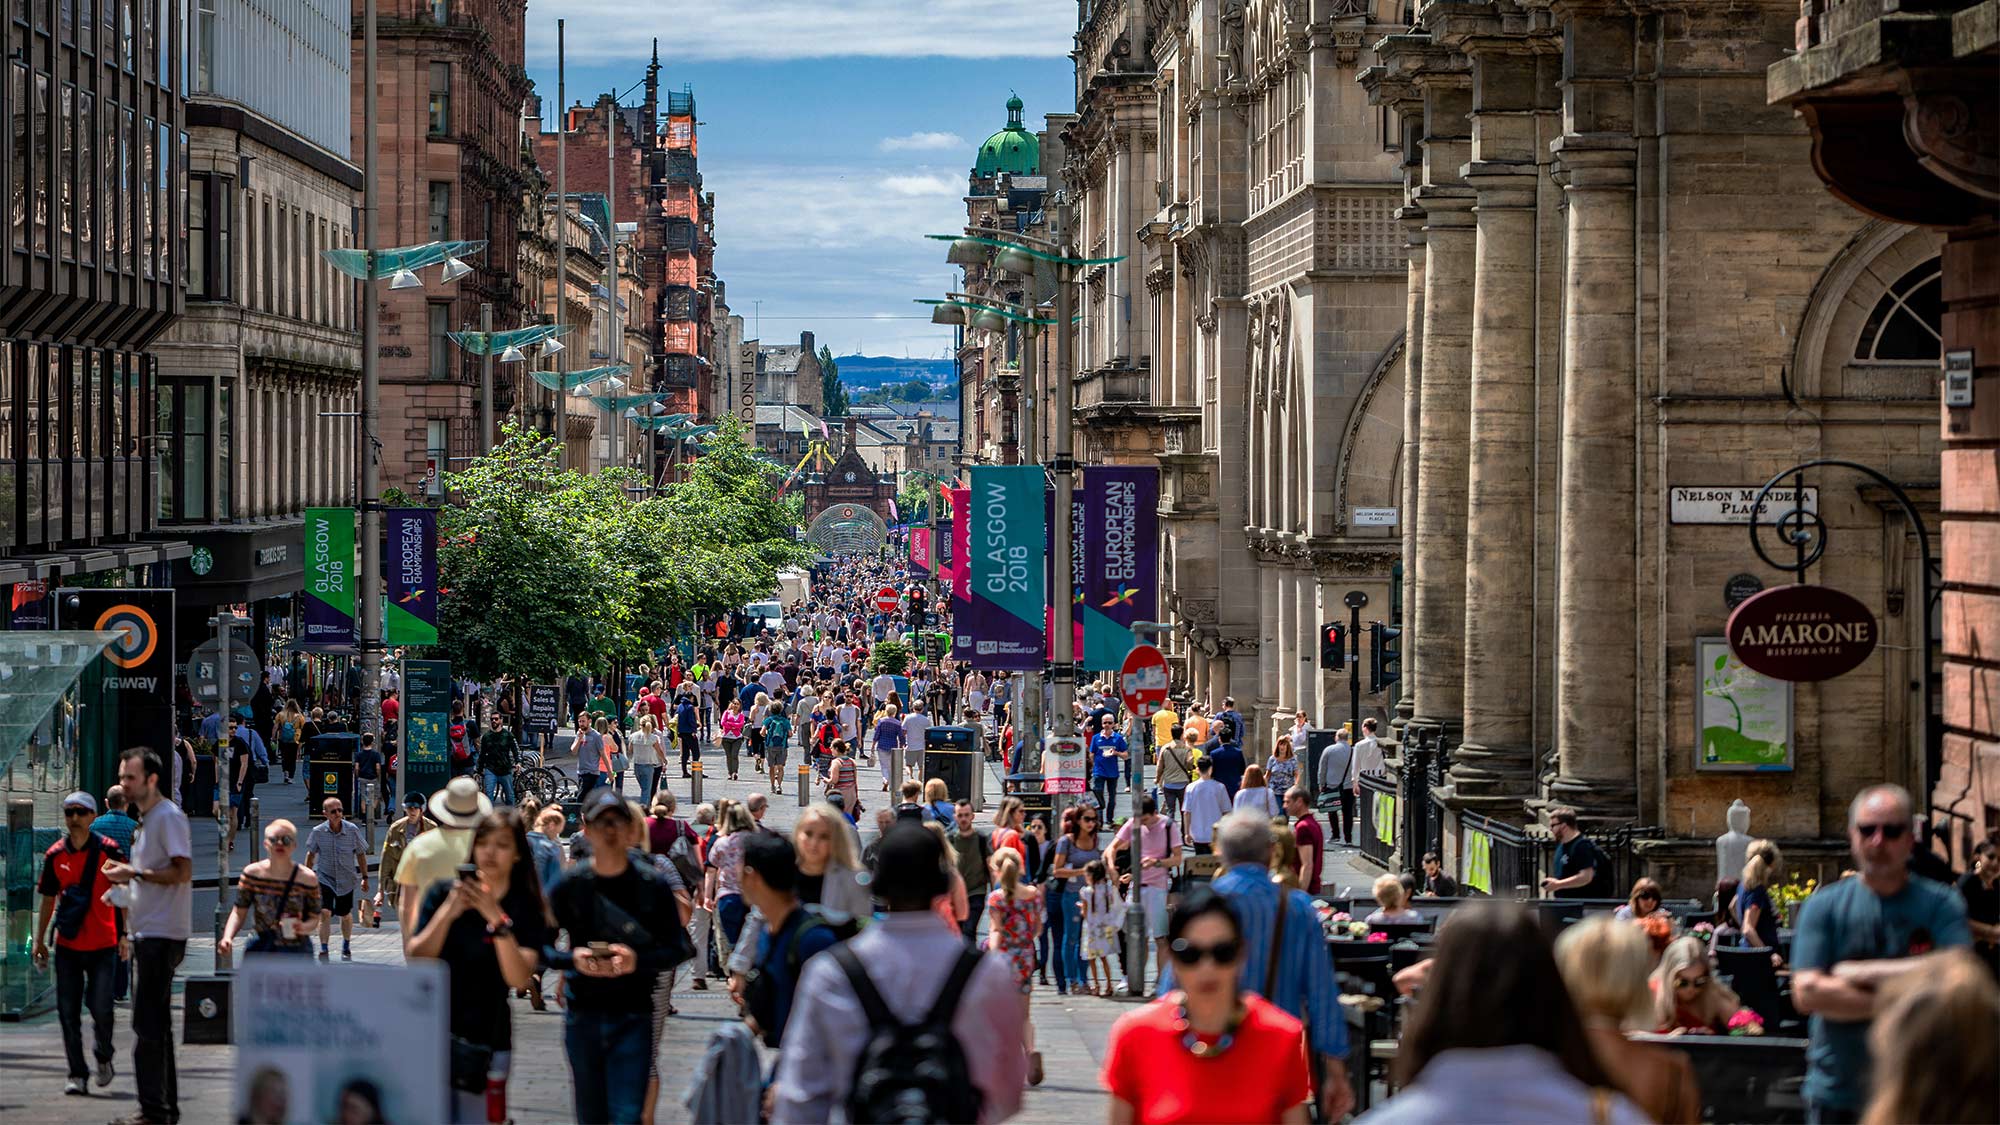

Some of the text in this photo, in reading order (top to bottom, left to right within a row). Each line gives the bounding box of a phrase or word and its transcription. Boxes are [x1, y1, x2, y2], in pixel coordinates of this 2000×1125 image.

[742, 350, 754, 367] ST
[1678, 490, 1811, 502] NELSON MNDEA
[987, 482, 1006, 592] GLASGOW
[1106, 482, 1122, 580] EUROPEAN
[1122, 482, 1136, 580] CHAMPIONSHIPS
[316, 518, 328, 592] GLASGOW
[402, 518, 413, 584] EUROPEAN
[414, 518, 422, 584] CHAMPIONSHIPS
[1009, 546, 1028, 592] 2018
[330, 560, 343, 592] 2018
[1739, 622, 1870, 647] AMARONE
[1776, 612, 1831, 622] PIZZERIA
[978, 642, 997, 652] HM
[1767, 646, 1842, 656] RISTORANTE
